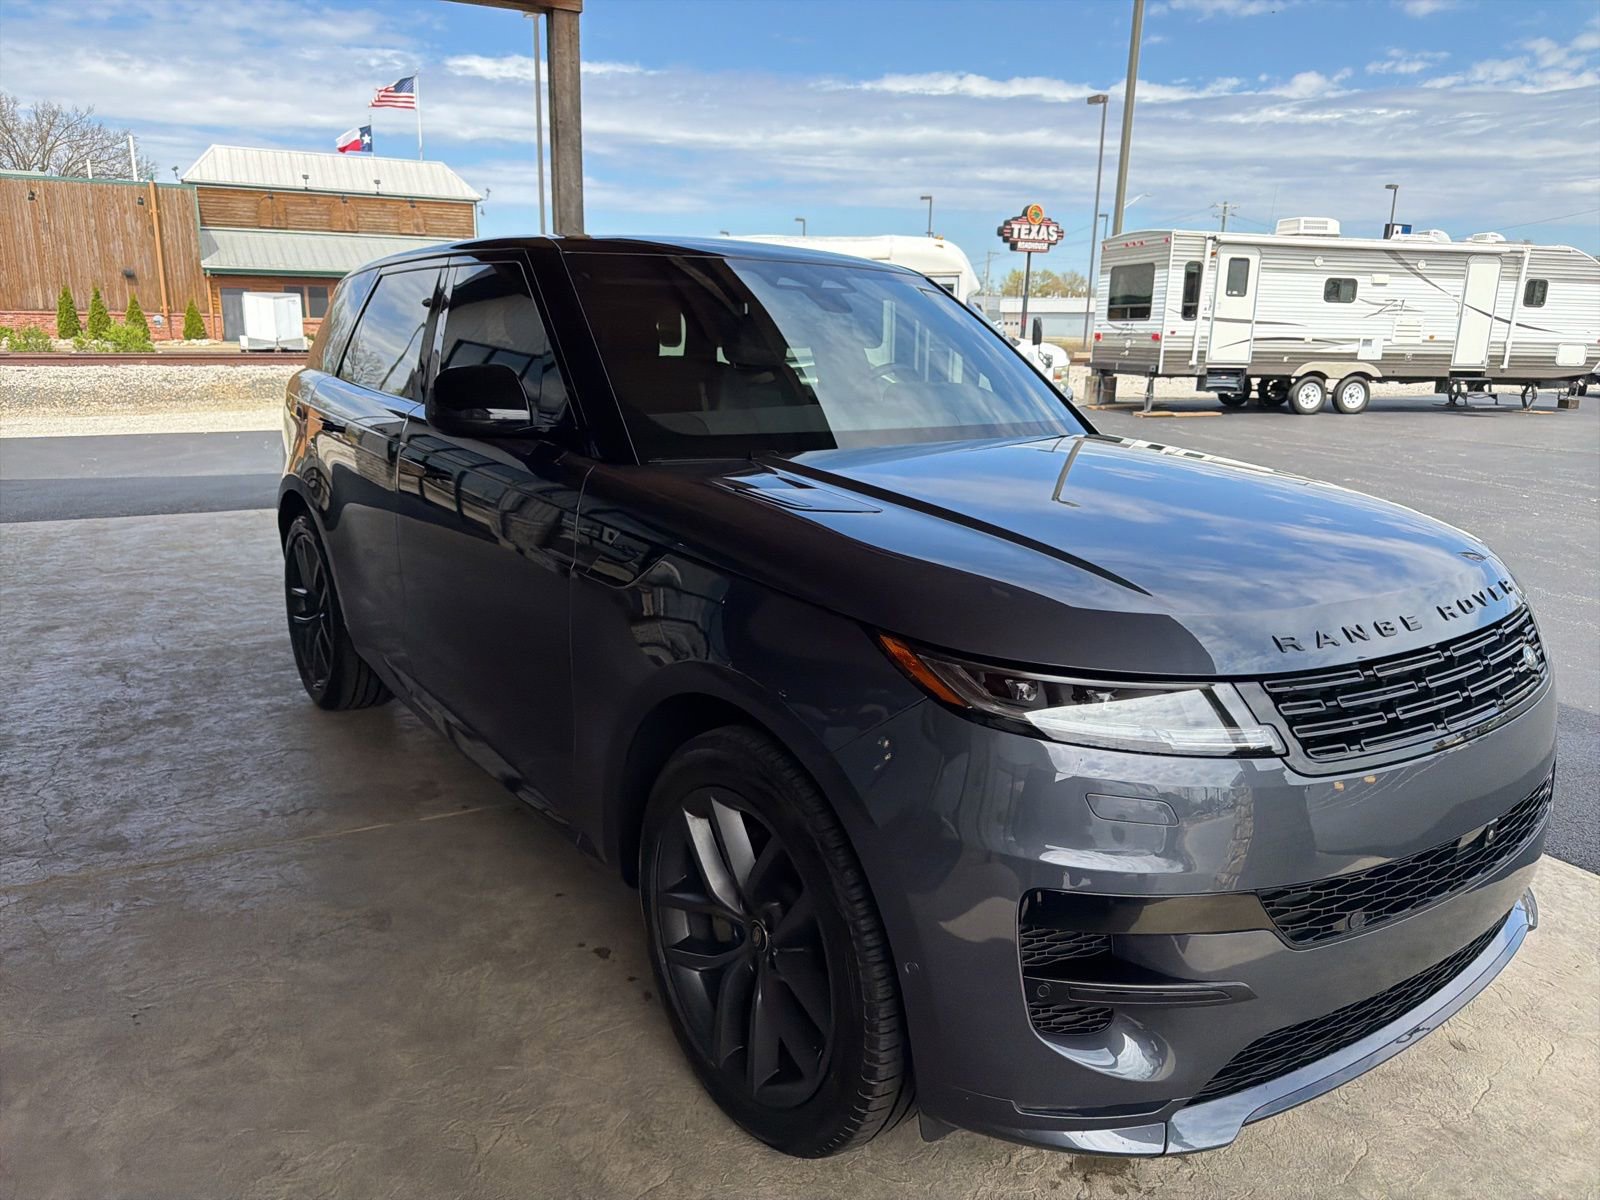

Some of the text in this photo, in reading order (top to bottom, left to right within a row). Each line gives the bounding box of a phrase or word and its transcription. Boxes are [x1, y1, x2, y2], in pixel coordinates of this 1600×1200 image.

[1011, 224, 1058, 241] TEXAS
[1271, 578, 1514, 653] RANGE ROVER
